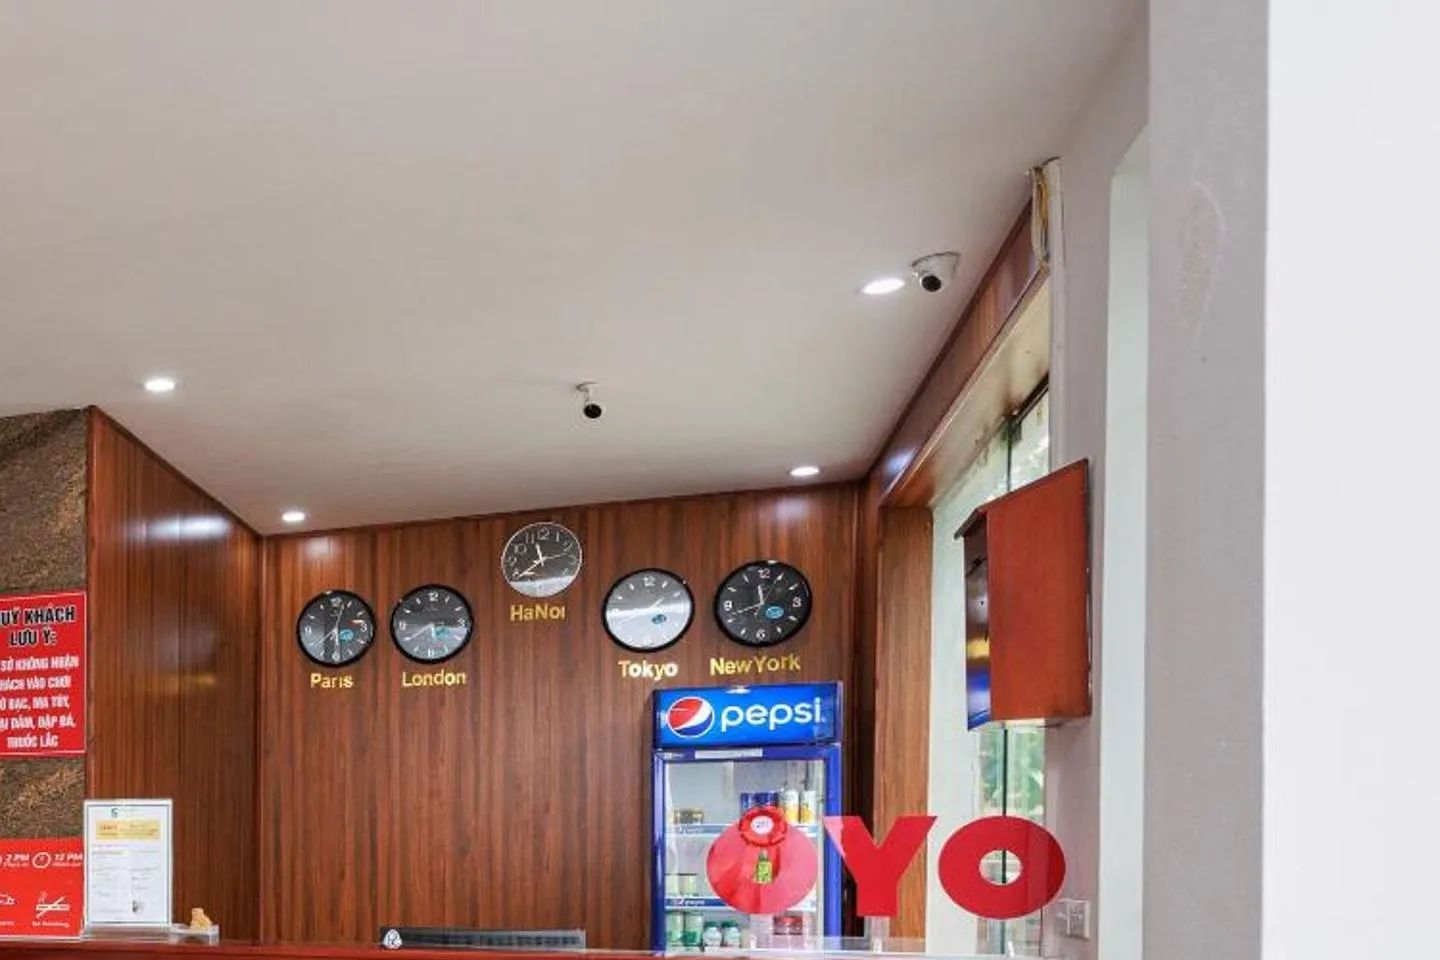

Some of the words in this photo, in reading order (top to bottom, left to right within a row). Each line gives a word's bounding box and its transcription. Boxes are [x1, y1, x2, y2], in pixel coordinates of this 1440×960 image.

[758, 568, 770, 578] 12
[23, 602, 76, 625] KHÁCH
[310, 672, 354, 688] Paris
[402, 669, 466, 687] London
[618, 660, 679, 681] Tokyo
[721, 697, 821, 732] pepsi
